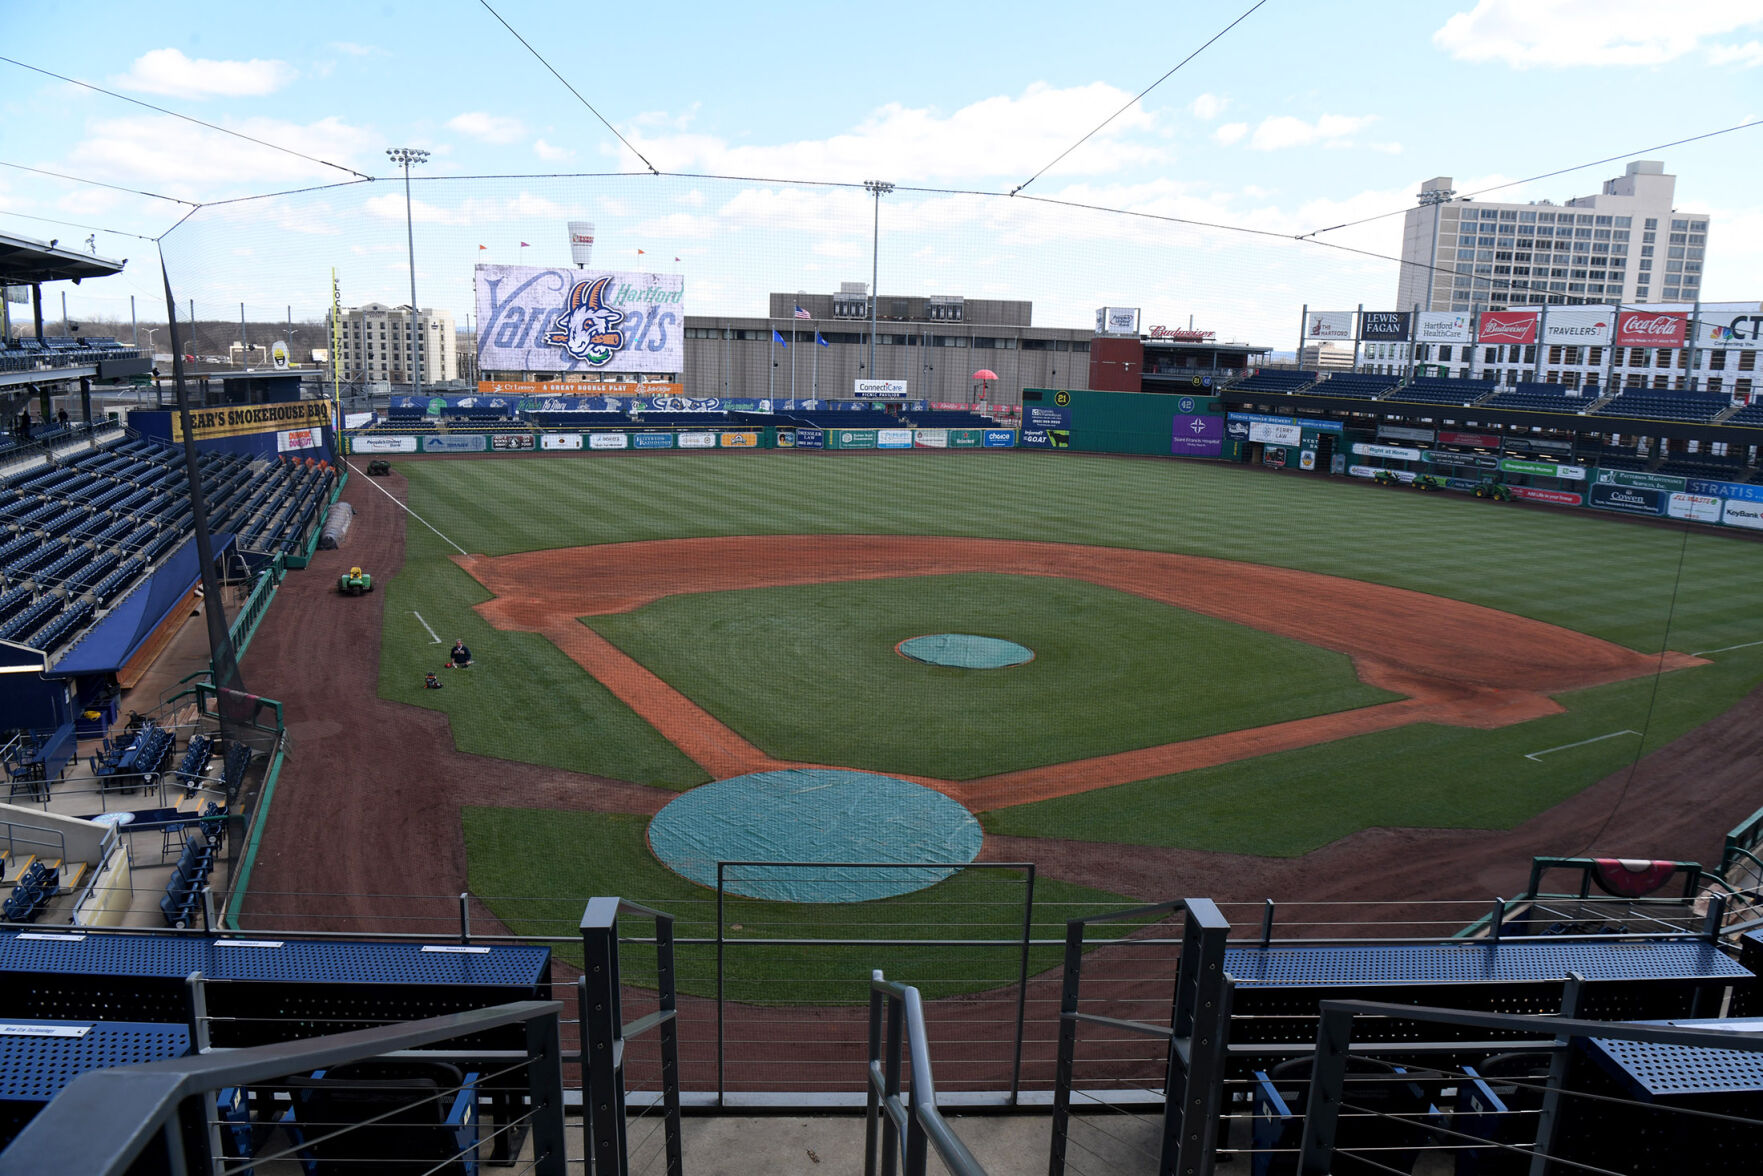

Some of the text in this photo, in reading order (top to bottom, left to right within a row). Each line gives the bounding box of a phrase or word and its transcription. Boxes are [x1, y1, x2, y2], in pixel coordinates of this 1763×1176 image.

[613, 283, 684, 306] Hartford
[1367, 313, 1399, 323] LEWIS
[1366, 323, 1400, 333] FAGAN
[1424, 321, 1453, 330] Hartford
[1485, 322, 1528, 333] Budweiser
[1622, 315, 1679, 334] Coca-Cola
[1730, 315, 1763, 341] CT
[1149, 324, 1216, 337] Budweiser
[1423, 329, 1461, 338] HealthCare
[1548, 326, 1599, 337] TRAVELERS
[859, 382, 903, 391] ConnectiCare
[1056, 394, 1067, 403] 21
[1181, 400, 1192, 409] 42
[228, 404, 305, 426] SMOKEHOUSE
[307, 403, 328, 419] BBQ
[988, 432, 1010, 440] choice
[1692, 482, 1754, 499] STRATIS
[1610, 491, 1645, 503] Cowen
[1687, 495, 1712, 504] WASTE
[1726, 508, 1759, 519] KeyBank
